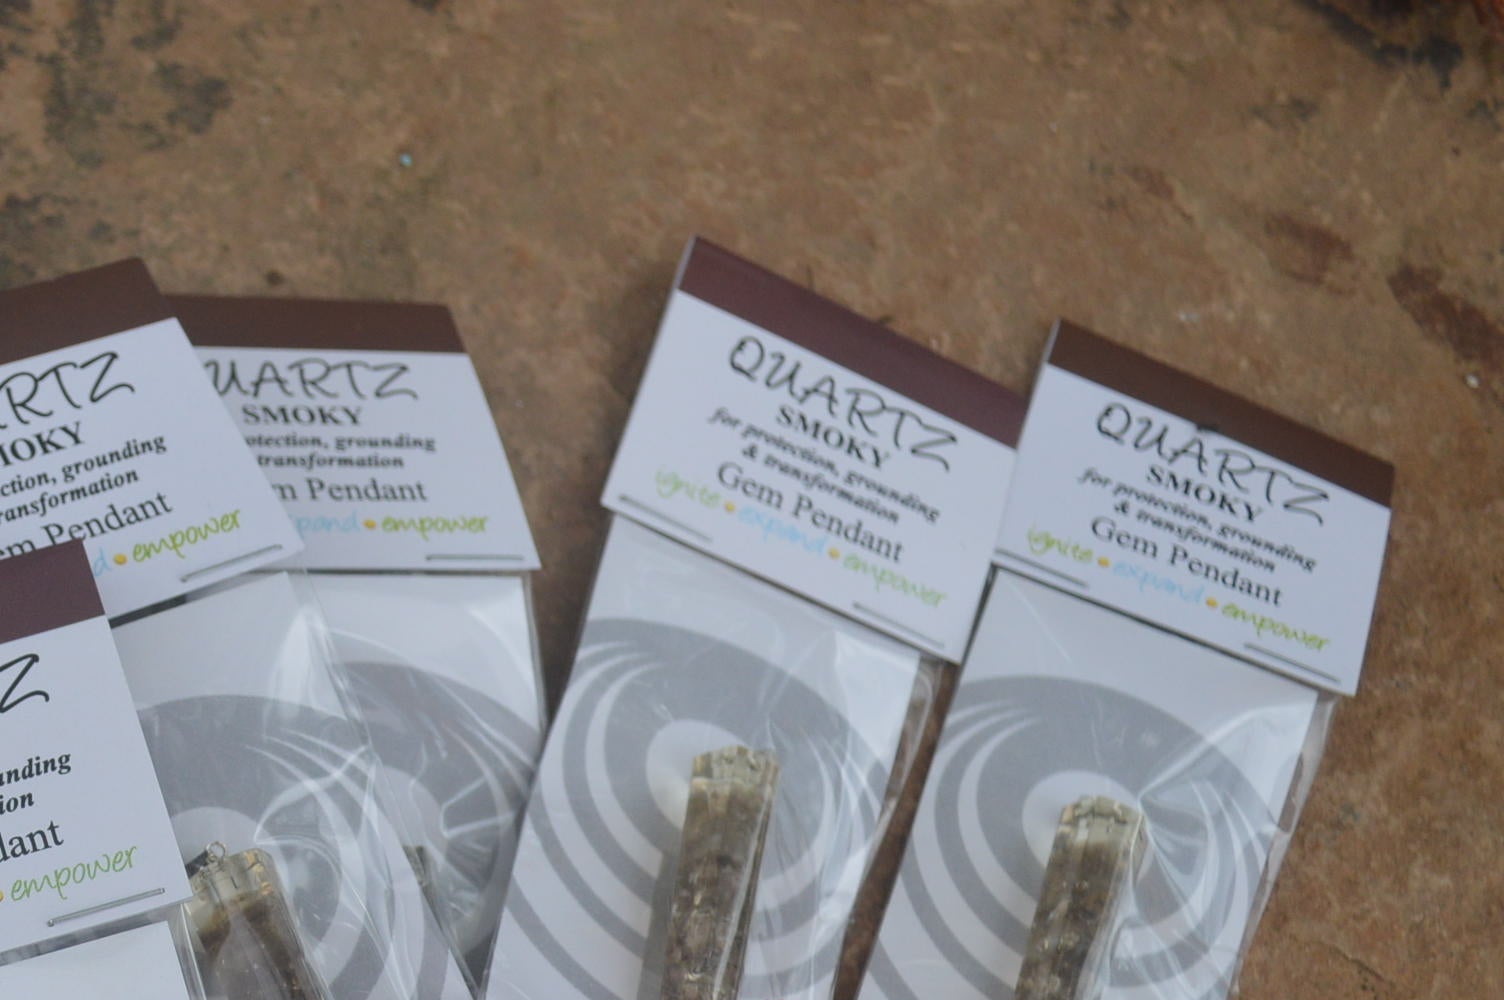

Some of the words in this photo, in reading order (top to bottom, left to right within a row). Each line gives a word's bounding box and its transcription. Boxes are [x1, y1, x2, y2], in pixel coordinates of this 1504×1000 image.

[204, 358, 418, 400] UARTZ
[729, 335, 958, 473] QUARTZ
[242, 404, 363, 425] SMOKY
[246, 432, 328, 450] otection,
[335, 433, 436, 452] grounding
[775, 405, 890, 469] SMOKY
[60, 432, 168, 487] grounding
[257, 453, 405, 471] transformation
[304, 477, 428, 501] Pendant
[707, 407, 741, 430] for
[742, 422, 840, 477] protection,
[843, 468, 941, 523] grounding
[742, 444, 758, 460] &
[760, 452, 899, 524] transformation
[1097, 402, 1329, 526] QUARTZ
[40, 492, 174, 547] Pendant
[717, 462, 784, 509] Gem
[794, 496, 904, 563] Pendant
[1077, 468, 1111, 489] for
[1114, 481, 1214, 532] protection,
[1217, 523, 1316, 573] grounding
[1147, 465, 1265, 523] SMOKY
[132, 508, 242, 563] empower
[382, 516, 488, 541] empower
[655, 464, 721, 508] ignite
[738, 507, 826, 555] expand
[844, 552, 947, 608] empower
[1114, 500, 1130, 516] &
[1136, 508, 1276, 573] transformation
[1027, 525, 1092, 563] ignite
[1112, 561, 1205, 603] expand
[1222, 602, 1331, 652] empower
[1091, 517, 1159, 558] Gem
[1168, 547, 1283, 606] Pendant
[10, 845, 138, 901] empower
